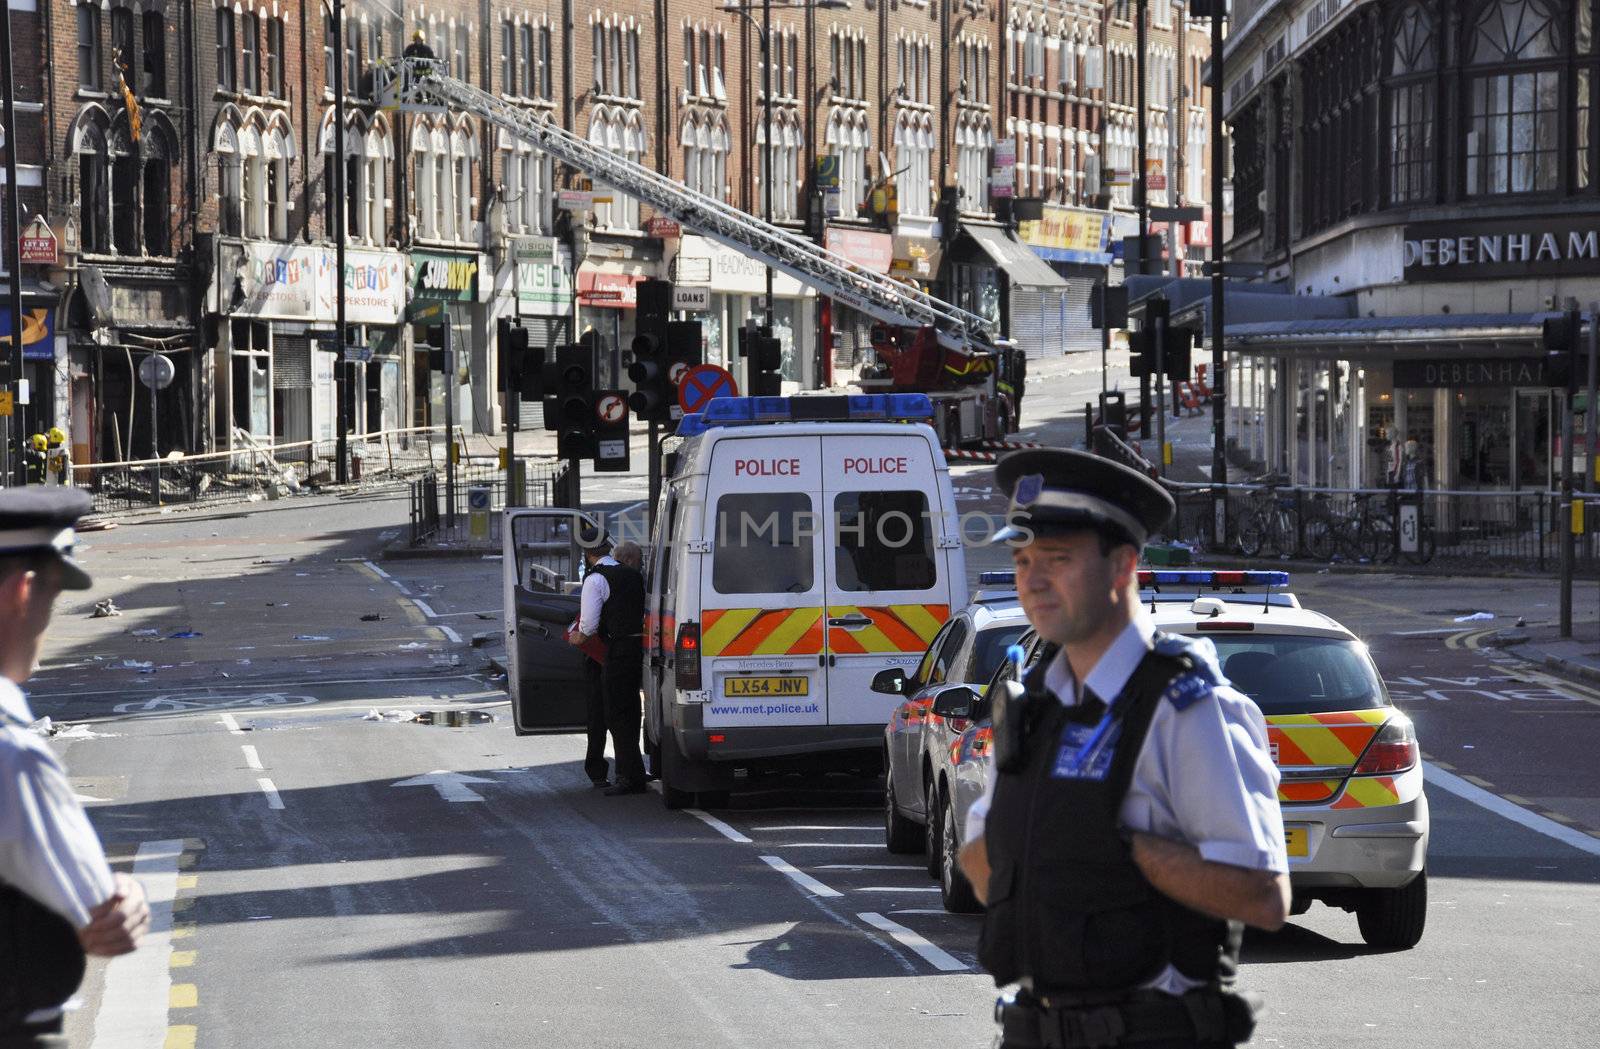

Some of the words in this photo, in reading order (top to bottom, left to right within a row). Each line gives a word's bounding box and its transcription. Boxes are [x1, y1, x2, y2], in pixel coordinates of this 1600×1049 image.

[516, 240, 553, 250] VISION
[253, 257, 300, 286] ARTY
[345, 262, 388, 292] ARTY
[423, 260, 477, 290] SUBWAY
[331, 295, 389, 307] SPERSTORE
[676, 292, 705, 304] LOANS
[1425, 362, 1543, 384] DEBENHA
[734, 458, 800, 476] POLICE
[843, 457, 907, 474] POLICE
[739, 660, 794, 669] Mercedes-Benz
[732, 680, 769, 693] LX54
[774, 680, 802, 692] JNV
[711, 704, 819, 715] www.met.police.uk
